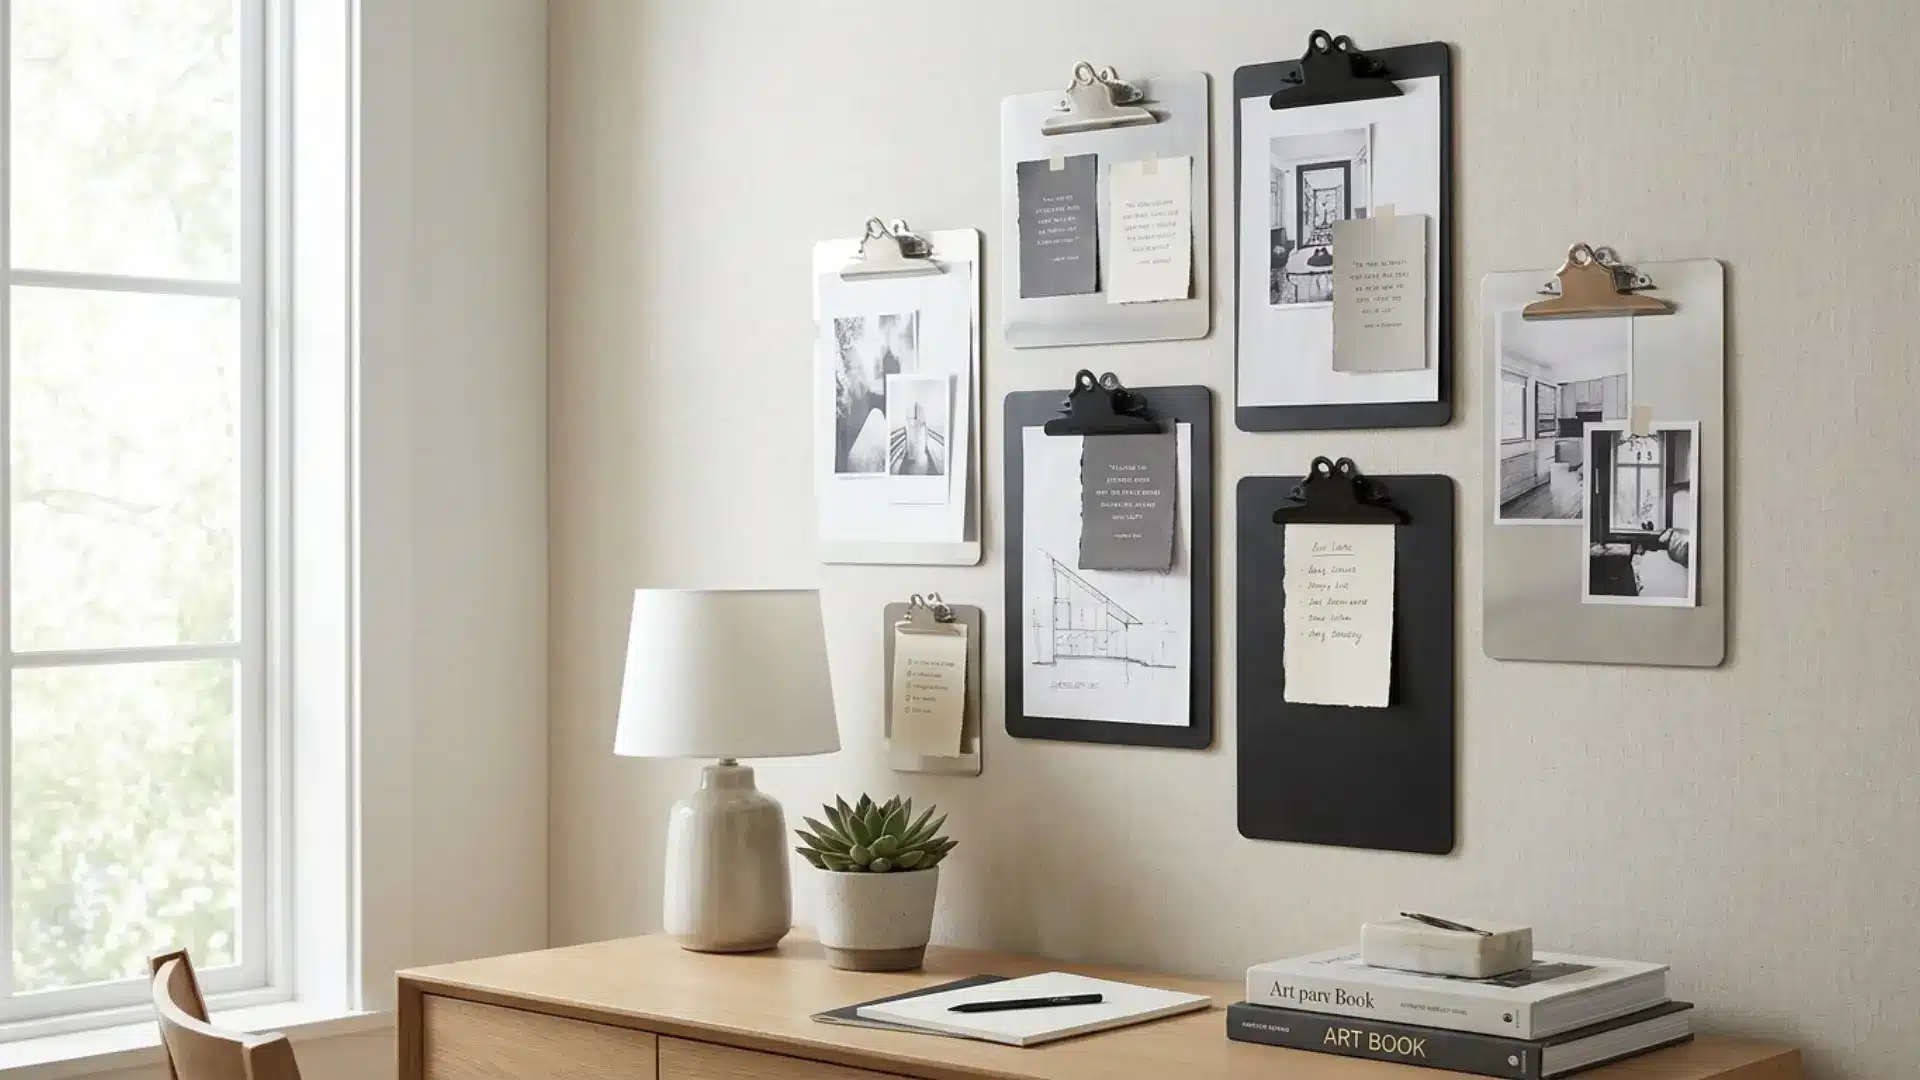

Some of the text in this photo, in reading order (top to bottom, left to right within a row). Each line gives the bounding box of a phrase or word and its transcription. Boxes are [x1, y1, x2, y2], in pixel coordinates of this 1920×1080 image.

[1270, 980, 1295, 999] Art
[1335, 988, 1375, 1009] Book
[1323, 1026, 1427, 1059] ART BOOK
